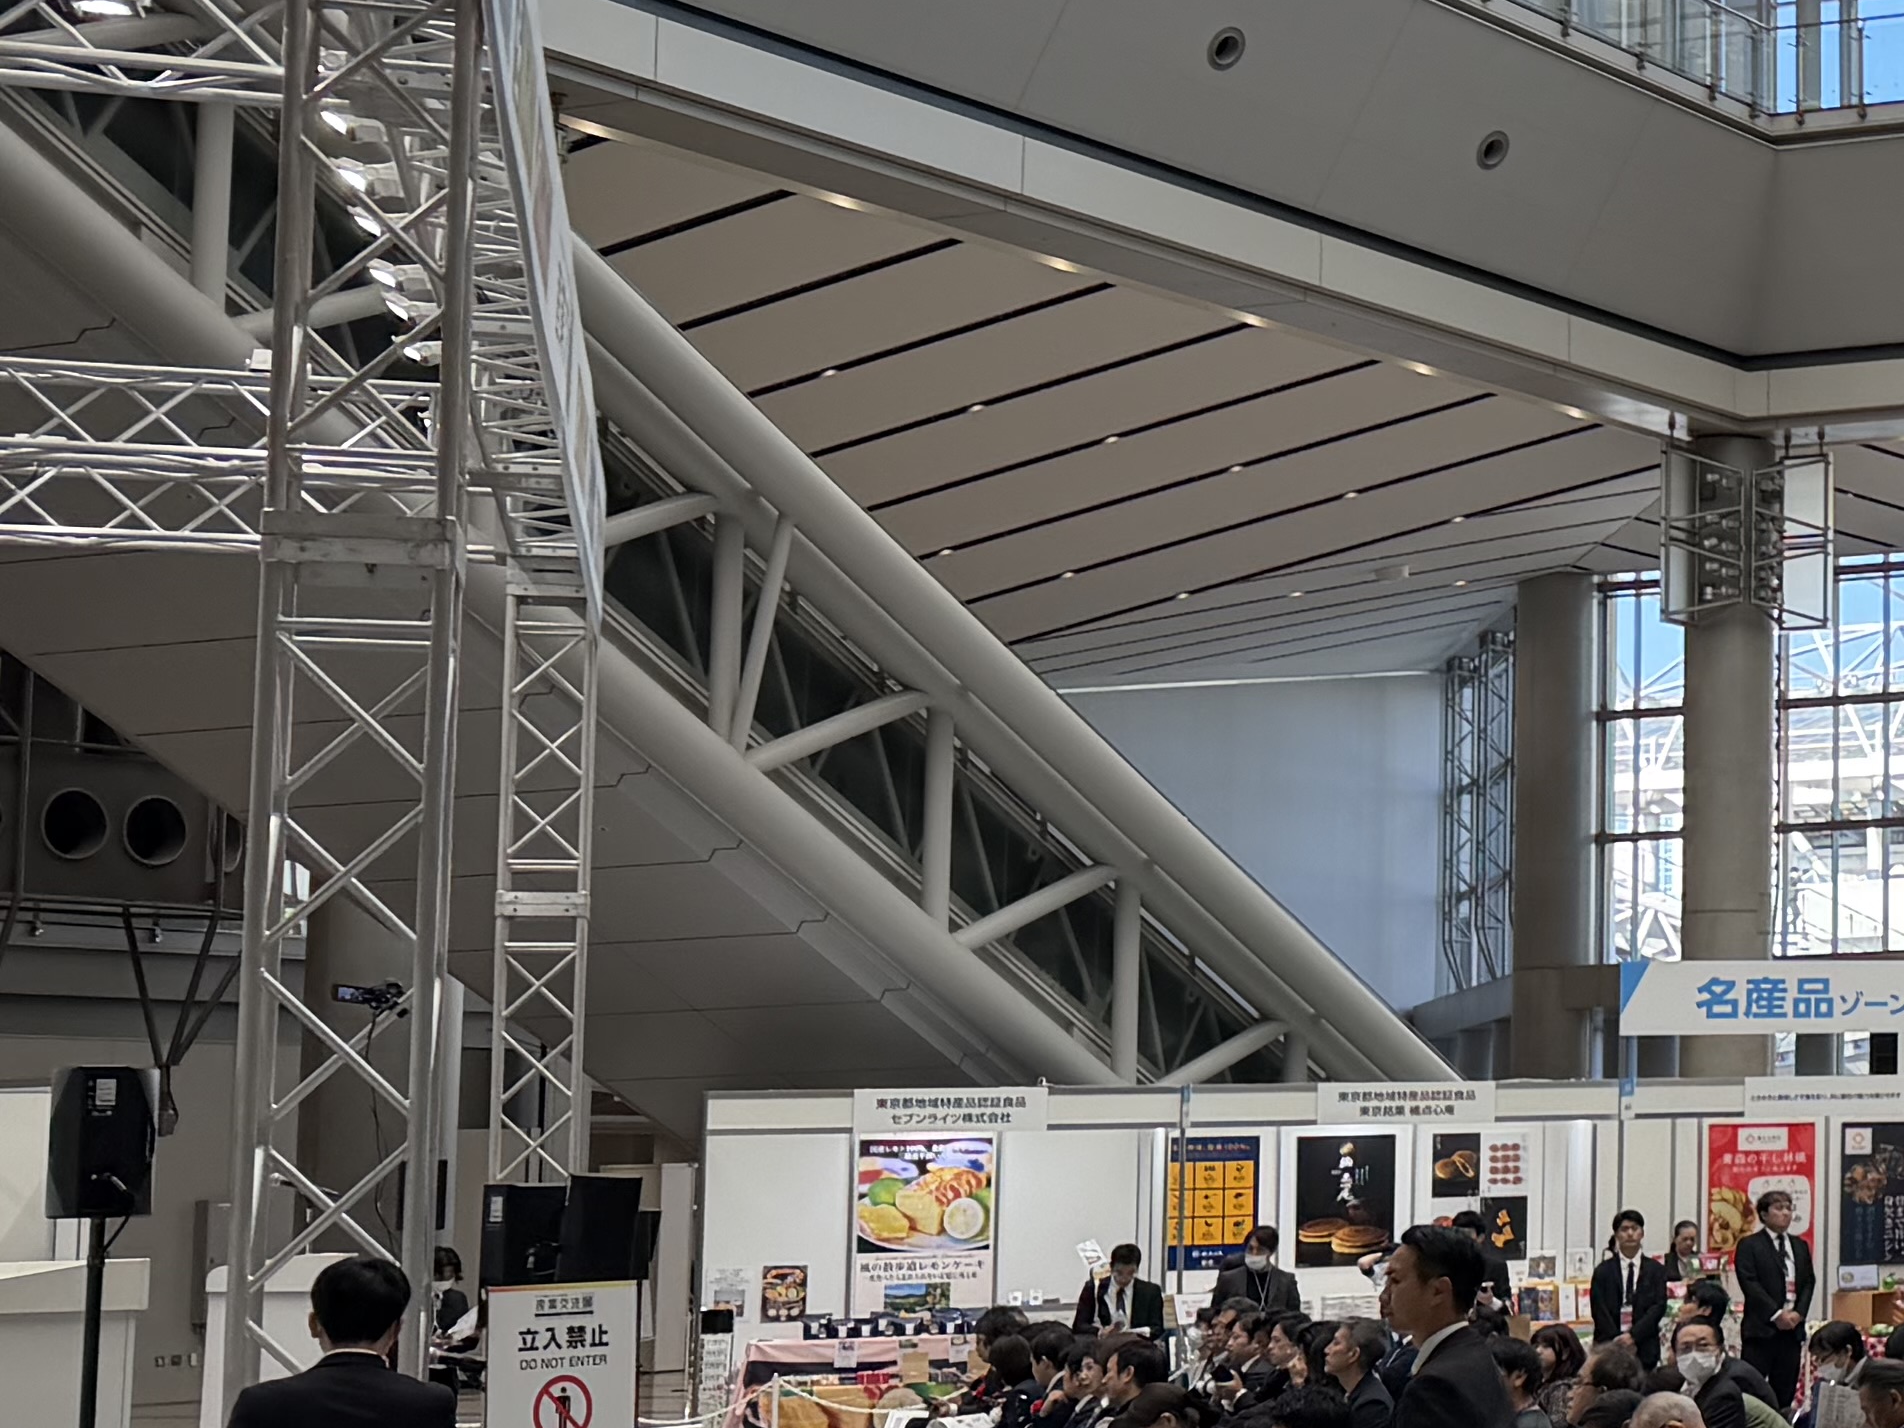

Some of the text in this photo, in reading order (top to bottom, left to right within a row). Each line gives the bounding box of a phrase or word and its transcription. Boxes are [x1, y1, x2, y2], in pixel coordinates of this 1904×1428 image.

[518, 1324, 609, 1352] 立入禁止
[520, 1354, 607, 1370] DO NOT ENTER
